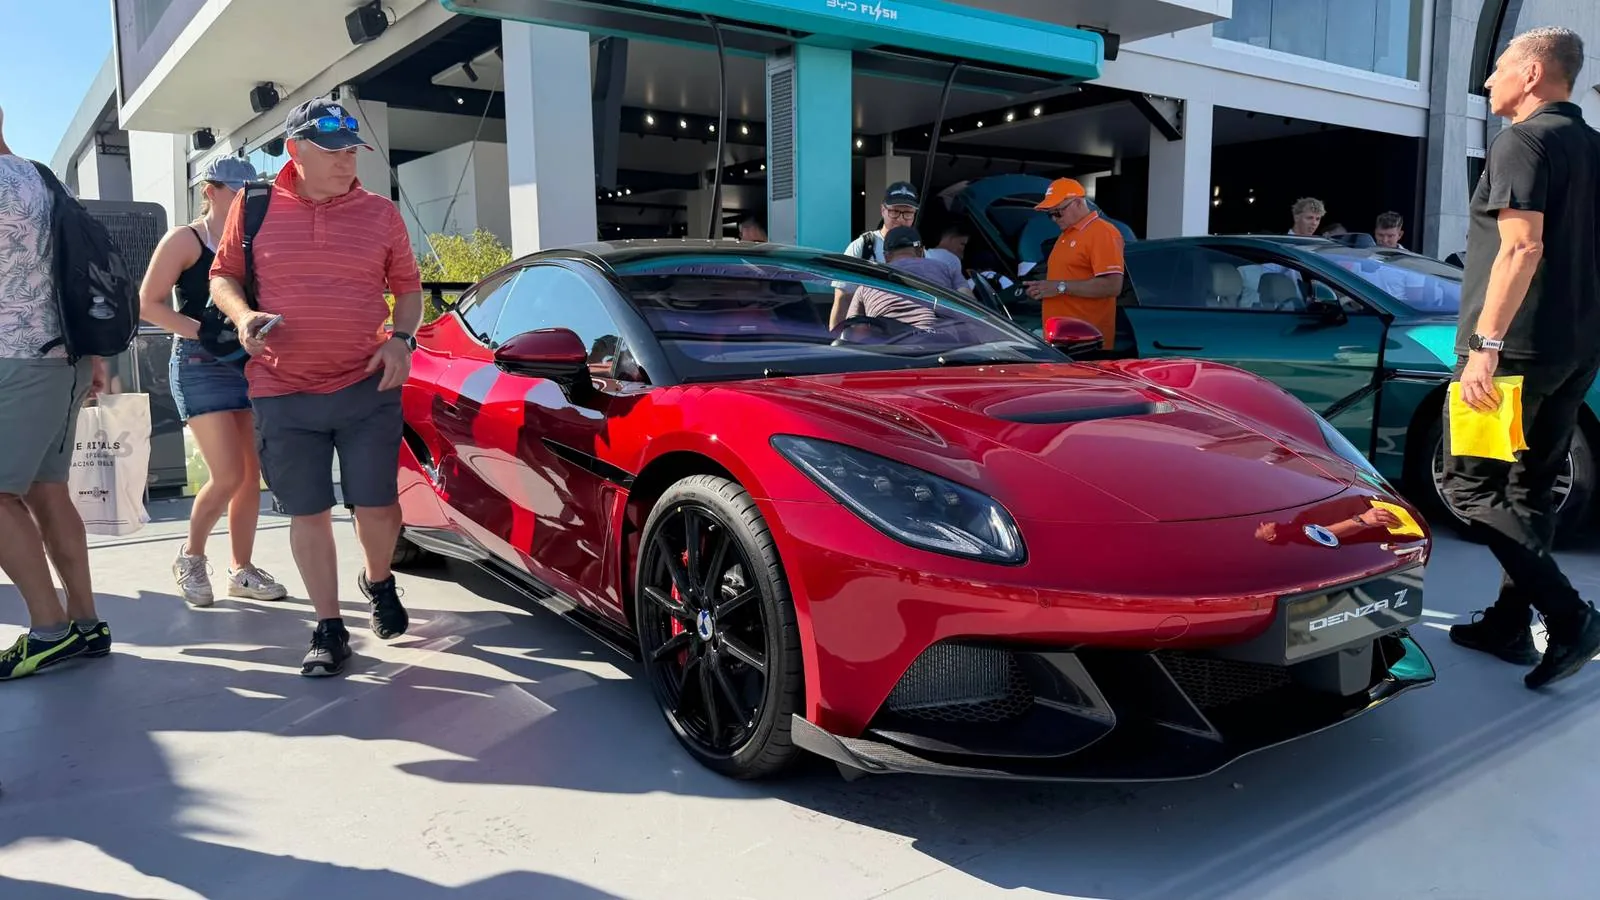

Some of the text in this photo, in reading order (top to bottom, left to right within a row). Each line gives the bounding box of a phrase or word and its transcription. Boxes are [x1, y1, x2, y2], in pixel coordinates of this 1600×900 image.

[827, 0, 857, 11] BYD
[1309, 588, 1408, 631] DENZA Z
